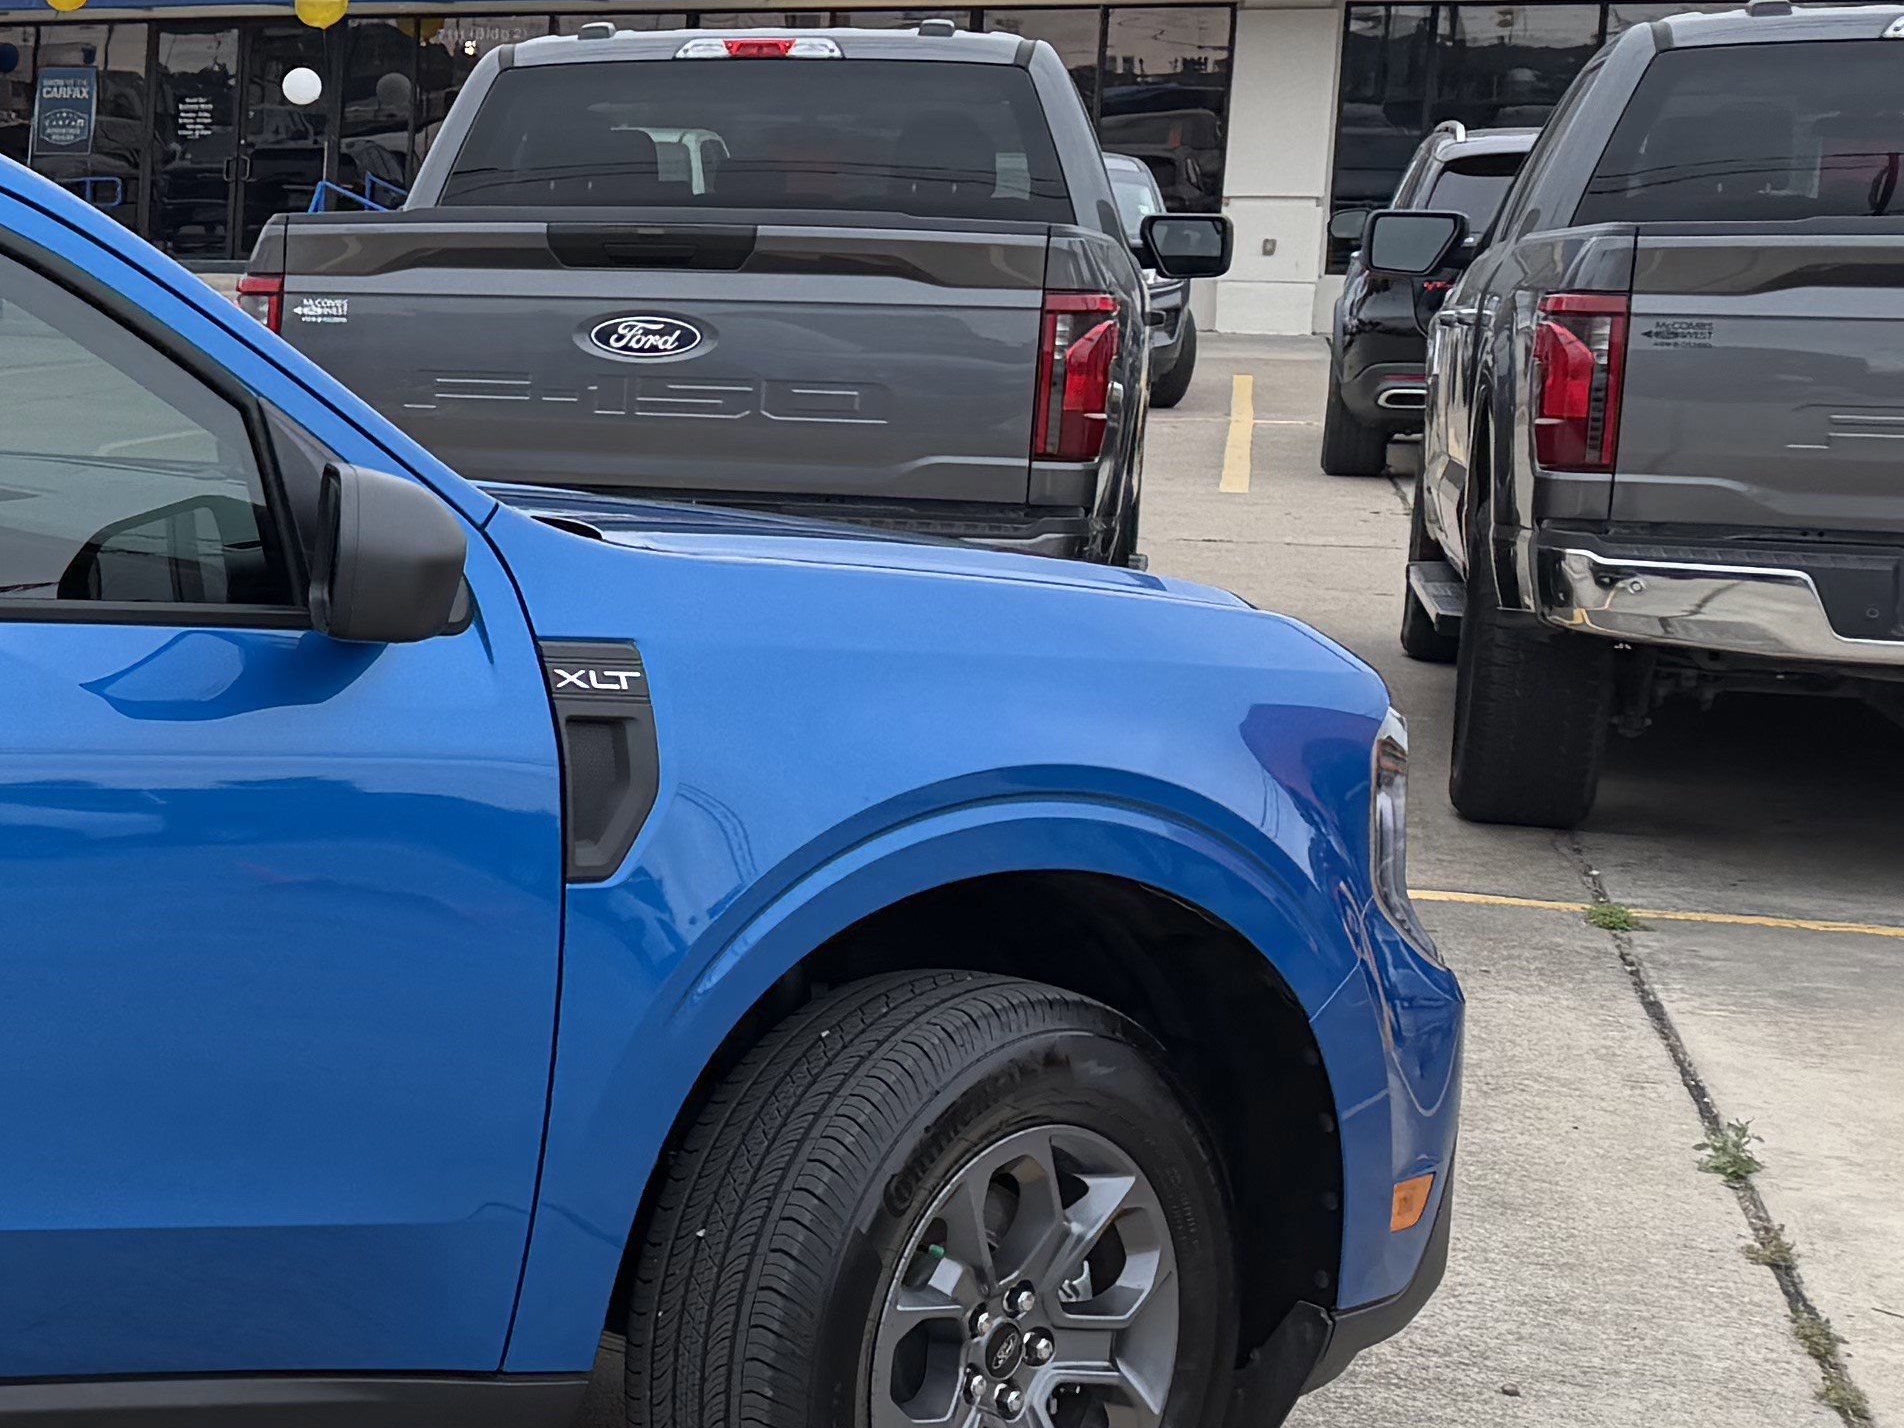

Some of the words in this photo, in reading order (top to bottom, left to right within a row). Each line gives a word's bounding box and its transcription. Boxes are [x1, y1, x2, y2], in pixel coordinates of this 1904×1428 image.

[42, 86, 89, 99] CARFAX
[608, 316, 683, 351] Ford
[403, 368, 890, 425] F-150
[553, 668, 641, 690] XLT
